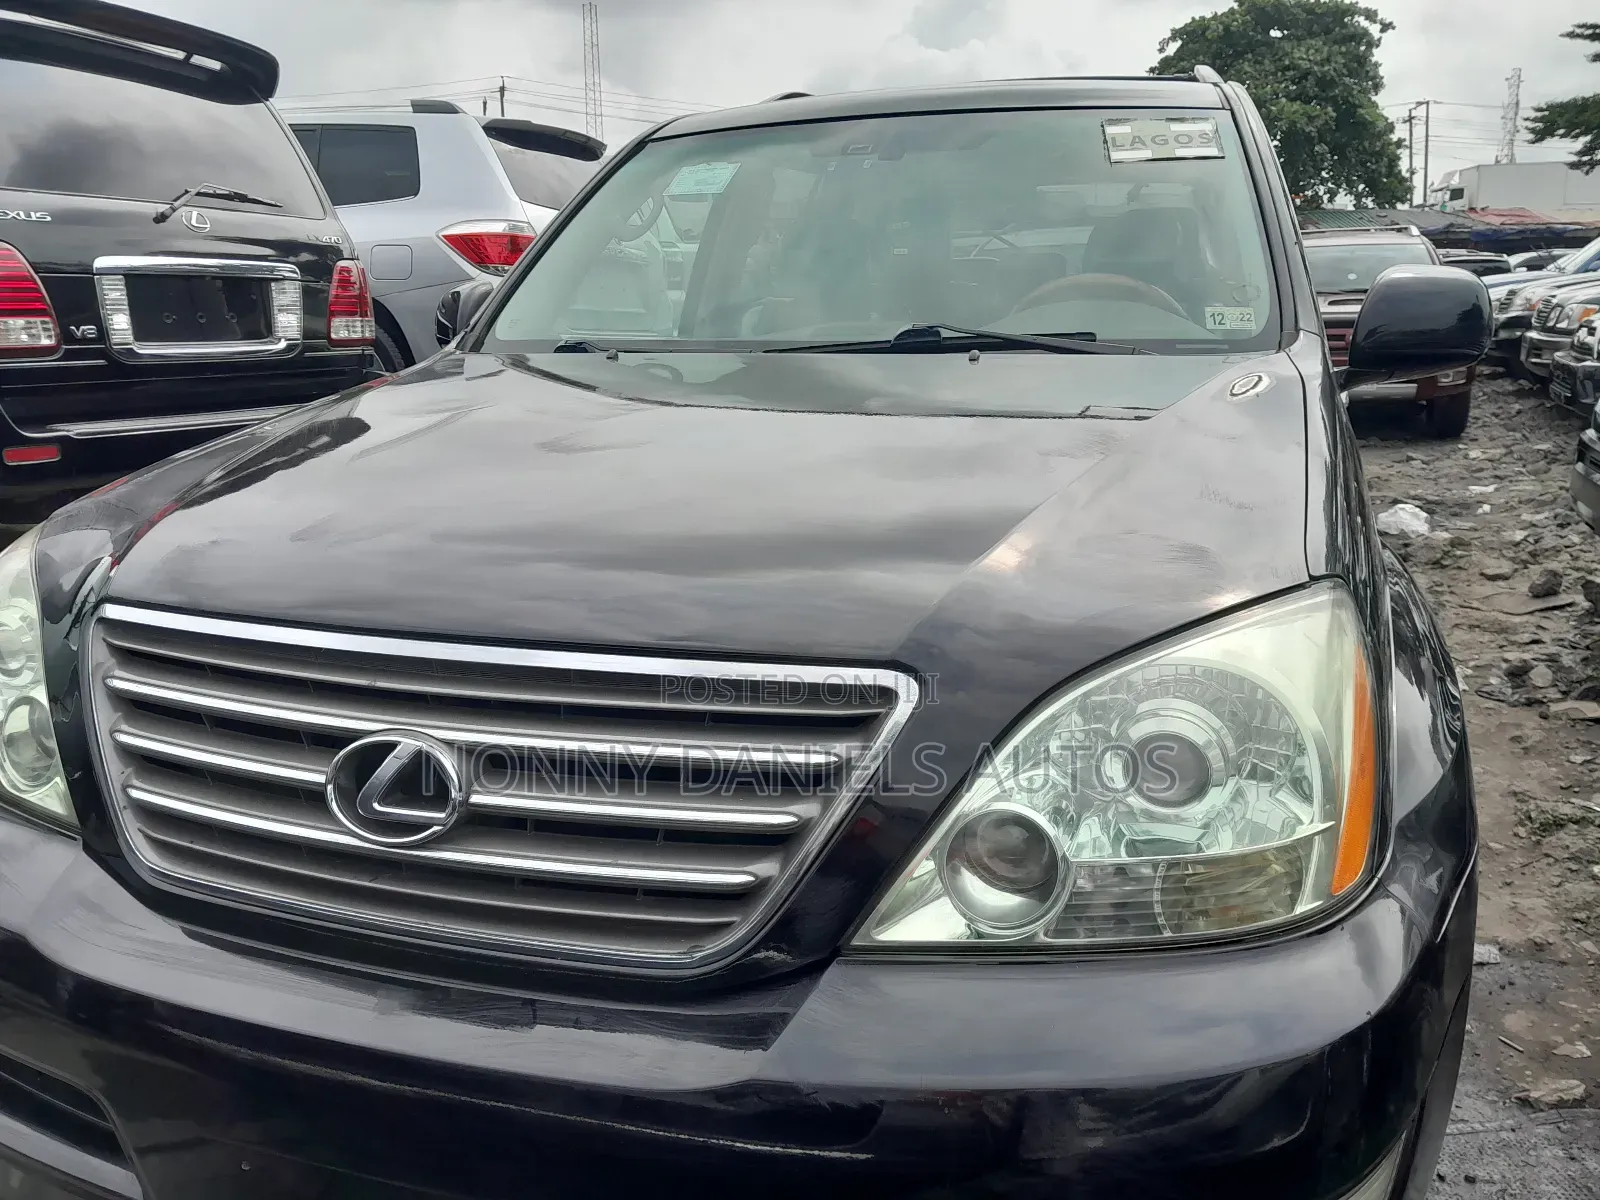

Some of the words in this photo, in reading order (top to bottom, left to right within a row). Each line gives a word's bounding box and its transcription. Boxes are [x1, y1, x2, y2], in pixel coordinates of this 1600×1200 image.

[1110, 133, 1214, 148] LAGOS
[1210, 312, 1226, 326] 12
[1239, 312, 1253, 322] 22
[69, 325, 98, 339] V8
